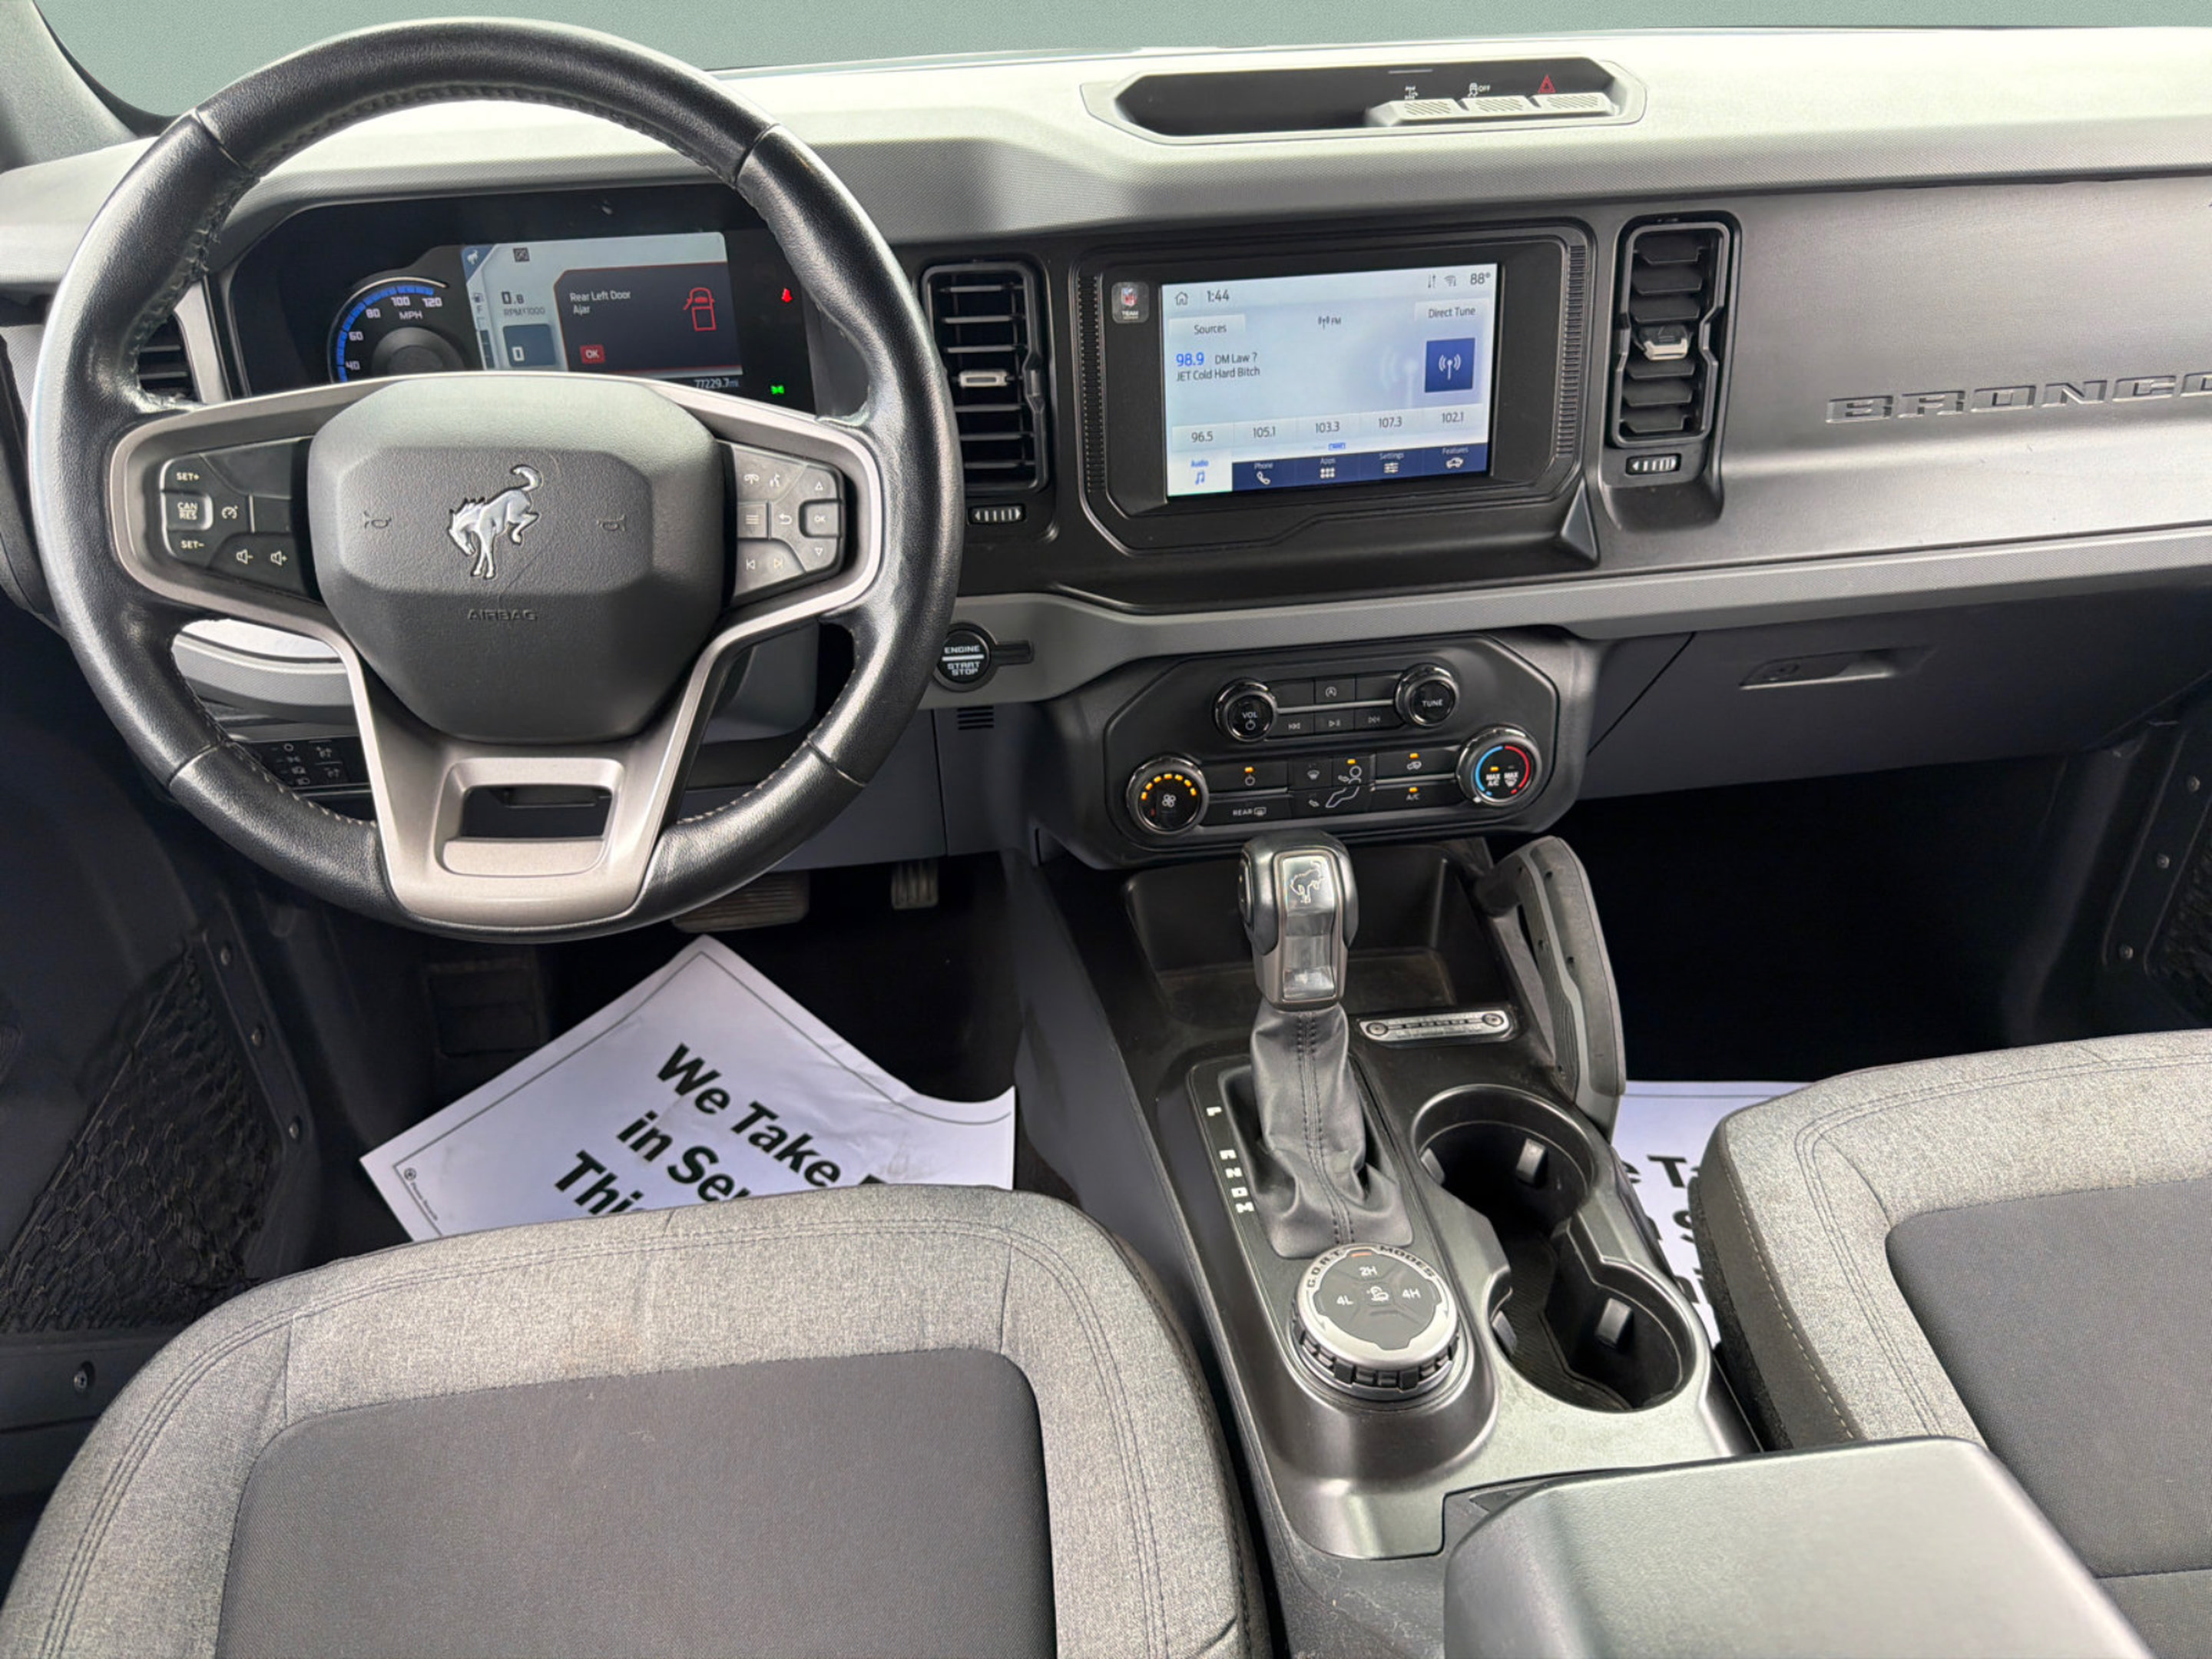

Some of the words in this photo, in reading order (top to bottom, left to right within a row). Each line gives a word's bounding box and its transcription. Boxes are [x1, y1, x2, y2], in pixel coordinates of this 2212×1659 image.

[1478, 84, 1491, 93] OFF
[1470, 272, 1491, 286] 88°
[390, 296, 411, 306] 100
[569, 292, 590, 302] Rear
[591, 290, 609, 301] Left
[610, 289, 631, 300] Door
[1207, 290, 1230, 303] 1:44
[422, 296, 443, 307] 120
[366, 308, 381, 319] 80
[399, 310, 423, 320] MPH
[573, 303, 591, 316] Ajar
[1428, 307, 1452, 319] Direct
[1455, 306, 1476, 317] Tune
[1331, 316, 1342, 325] FM
[1194, 323, 1227, 335] Sources
[348, 331, 364, 341] 60
[585, 349, 600, 359] OK
[1175, 352, 1205, 366] 98.9
[1215, 354, 1230, 365] DM
[1231, 354, 1250, 364] Law
[1252, 352, 1257, 363] ?
[346, 360, 360, 371] 40
[1177, 371, 1191, 382] JET
[1193, 369, 1213, 380] Cold
[1214, 367, 1236, 379] Hard
[1237, 366, 1260, 378] Bitch
[1379, 416, 1402, 428] 107.3
[1442, 412, 1464, 423] 102.1
[1253, 426, 1276, 438] 105.1
[1316, 421, 1339, 433] 103.3
[1191, 431, 1214, 443] 96.5
[1191, 459, 1209, 468] Audio
[176, 472, 200, 481] SET+
[179, 511, 197, 520] RES
[813, 515, 826, 524] OK
[467, 609, 538, 621] AIRBAG
[944, 645, 981, 654] ENGINE
[947, 661, 981, 670] START
[1422, 699, 1443, 707] TUNE
[1406, 793, 1420, 801] A/C
[657, 1043, 730, 1114] We
[730, 1101, 841, 1187] Take
[1207, 1107, 1222, 1117] P
[617, 1110, 674, 1162] in
[1225, 1167, 1243, 1178] N
[554, 1150, 647, 1215] Thi
[1236, 1202, 1254, 1214] M
[1379, 1246, 1435, 1277] MODES
[1359, 1267, 1377, 1276] 2H
[1402, 1289, 1421, 1298] 4H
[1336, 1296, 1353, 1305] 4L
